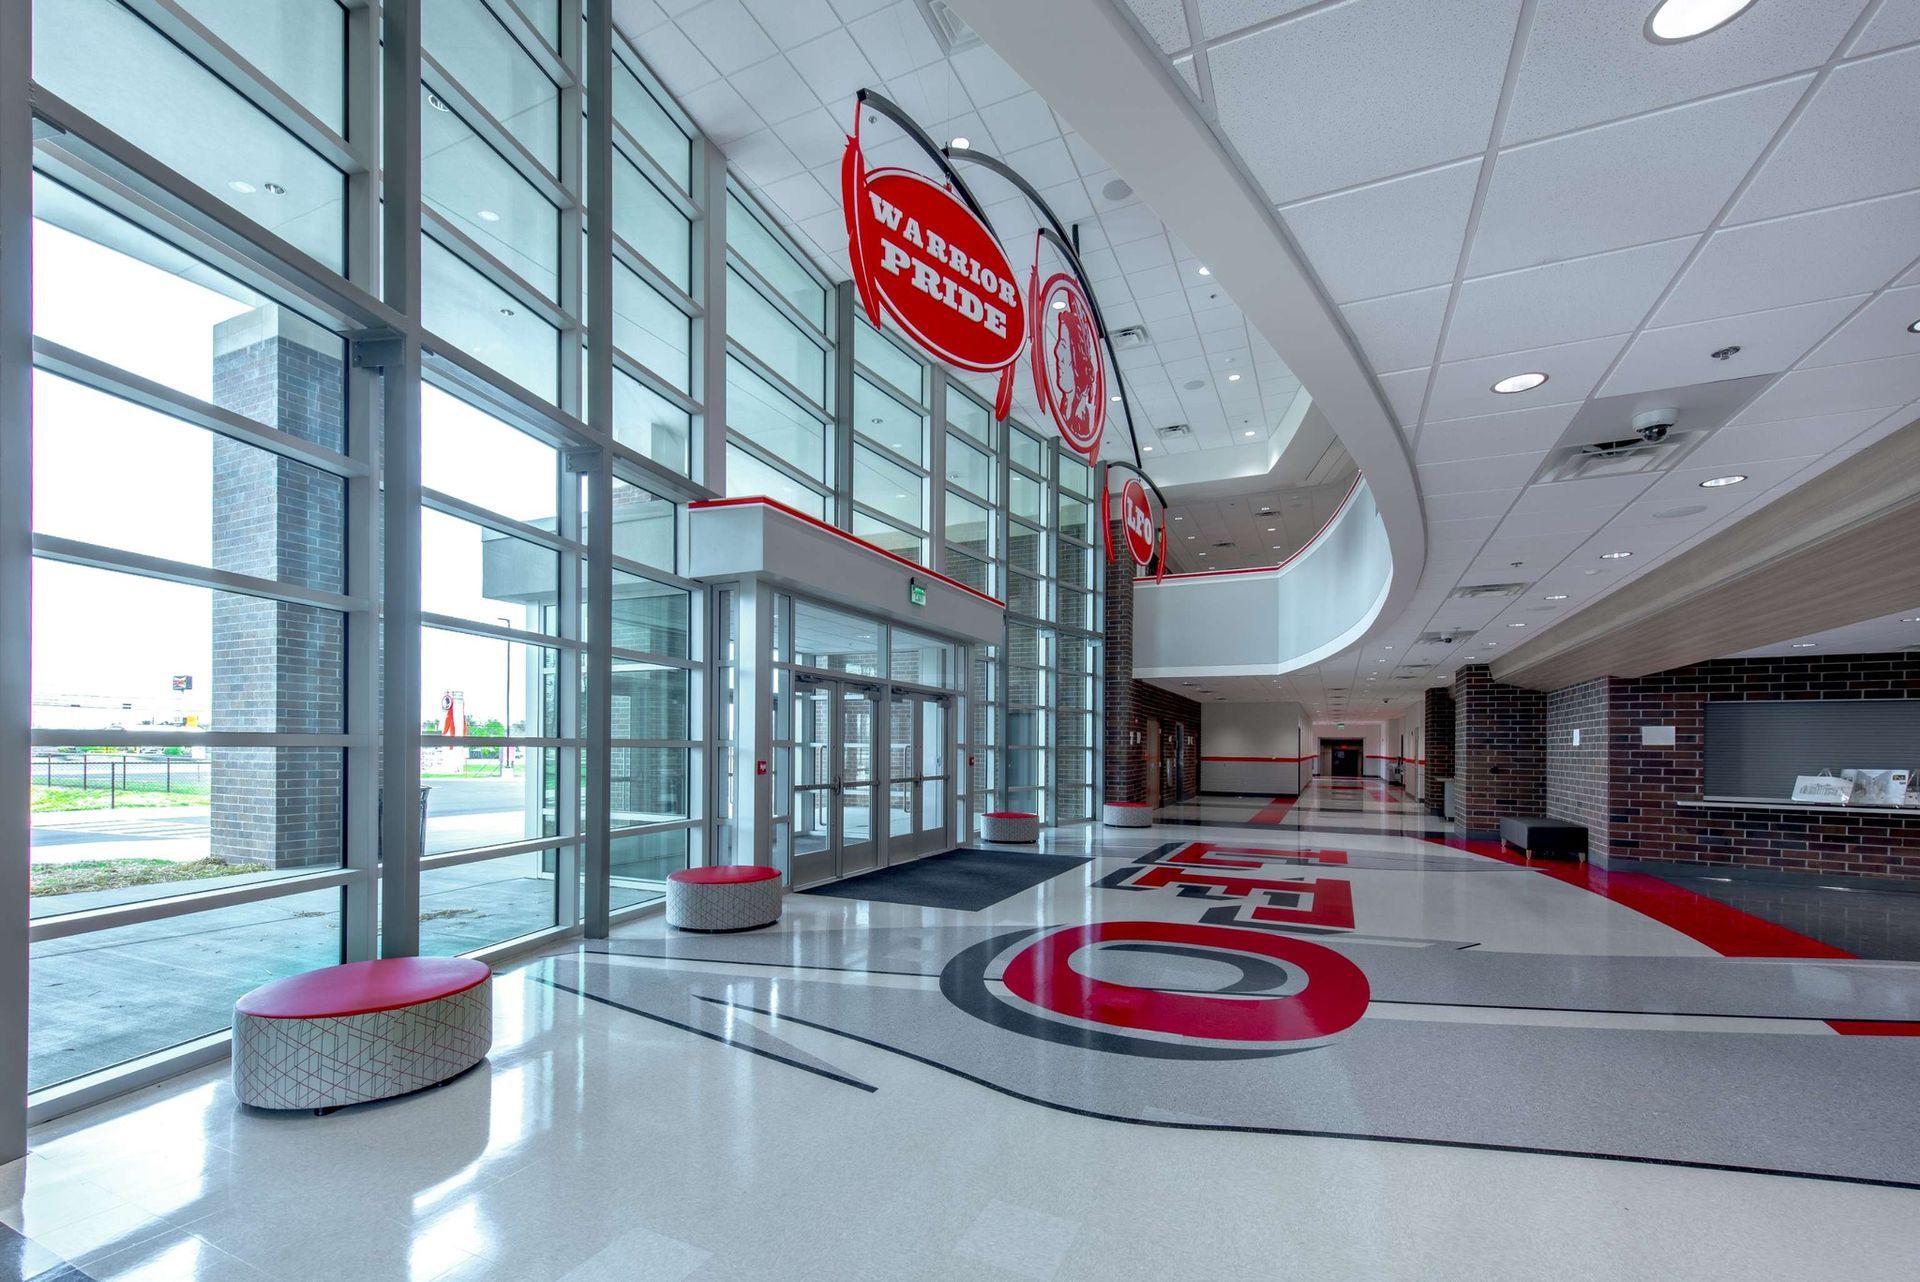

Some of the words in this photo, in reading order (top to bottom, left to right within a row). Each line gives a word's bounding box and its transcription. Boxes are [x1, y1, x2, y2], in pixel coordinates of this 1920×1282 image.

[869, 191, 1017, 308] WARRIOR
[881, 238, 1007, 339] PRIDE
[1127, 497, 1153, 545] LFO
